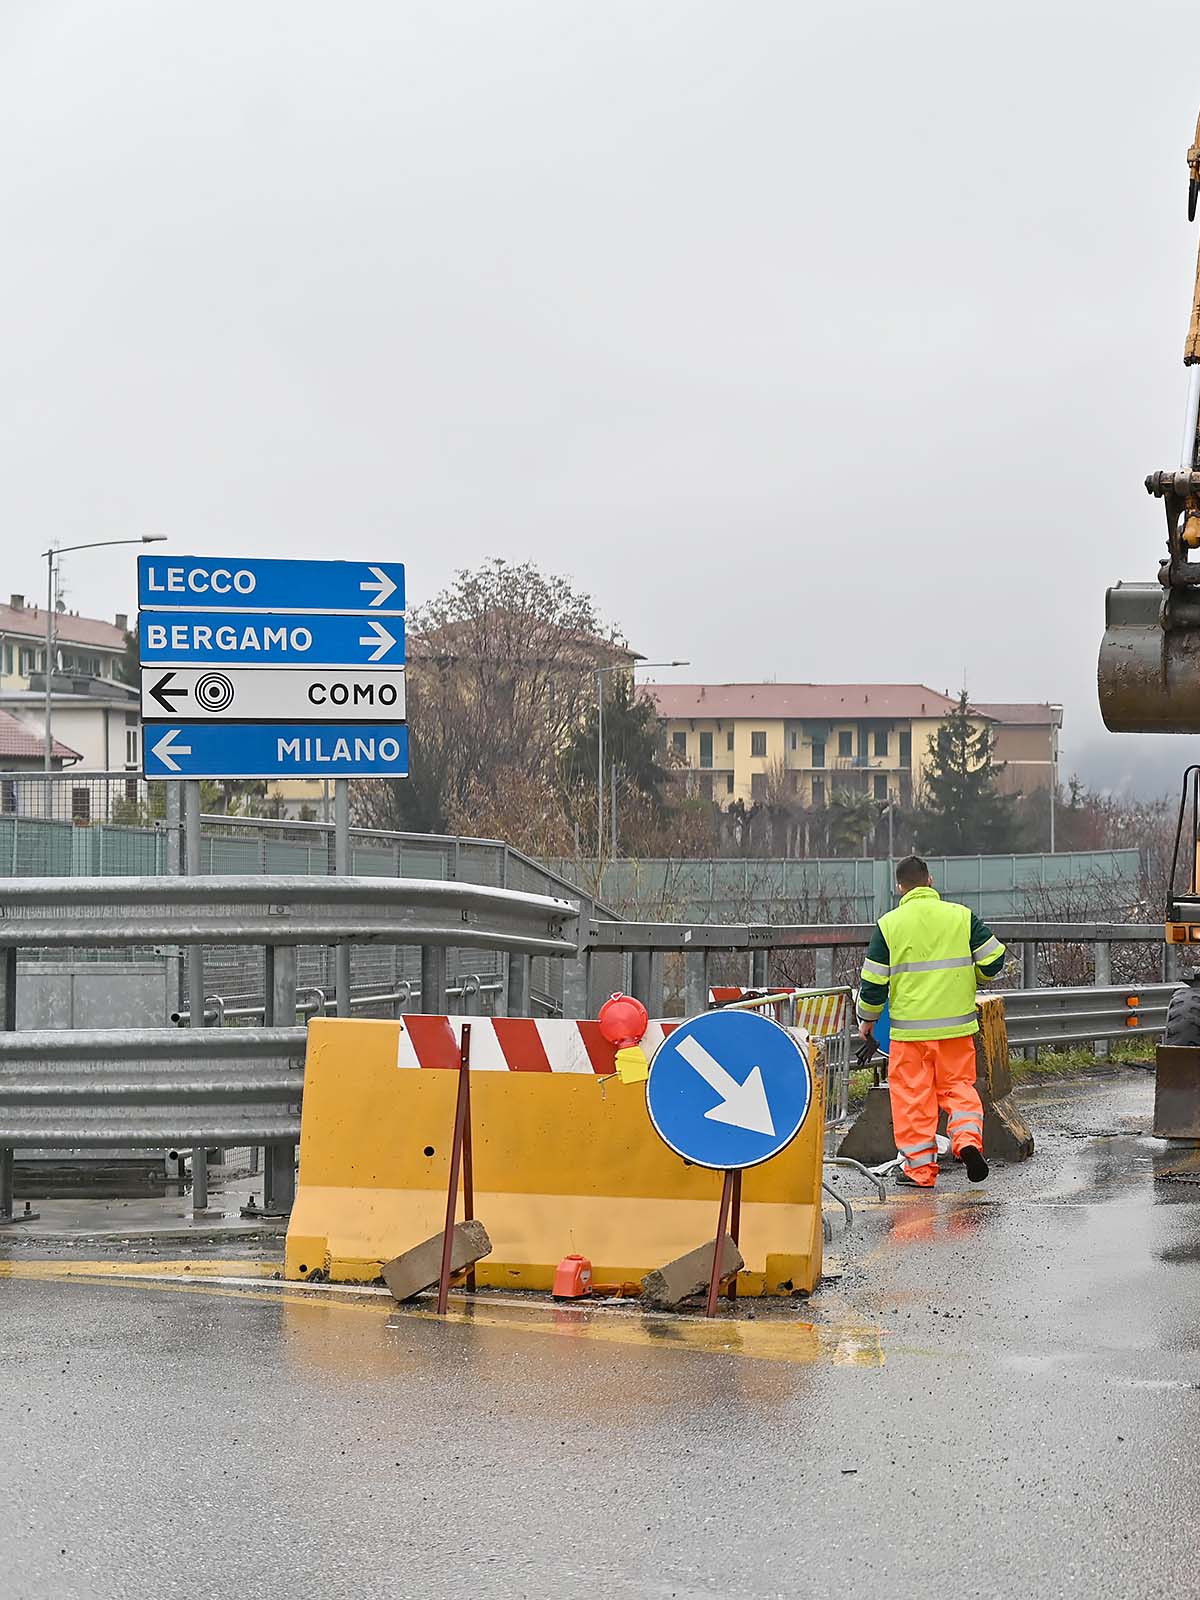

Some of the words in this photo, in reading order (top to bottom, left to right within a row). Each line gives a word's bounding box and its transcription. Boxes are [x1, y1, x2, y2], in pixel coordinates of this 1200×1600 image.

[148, 567, 256, 593] LECCO
[147, 625, 313, 651] BERGAMO
[308, 683, 397, 705] COMO
[277, 738, 400, 761] MILANO
